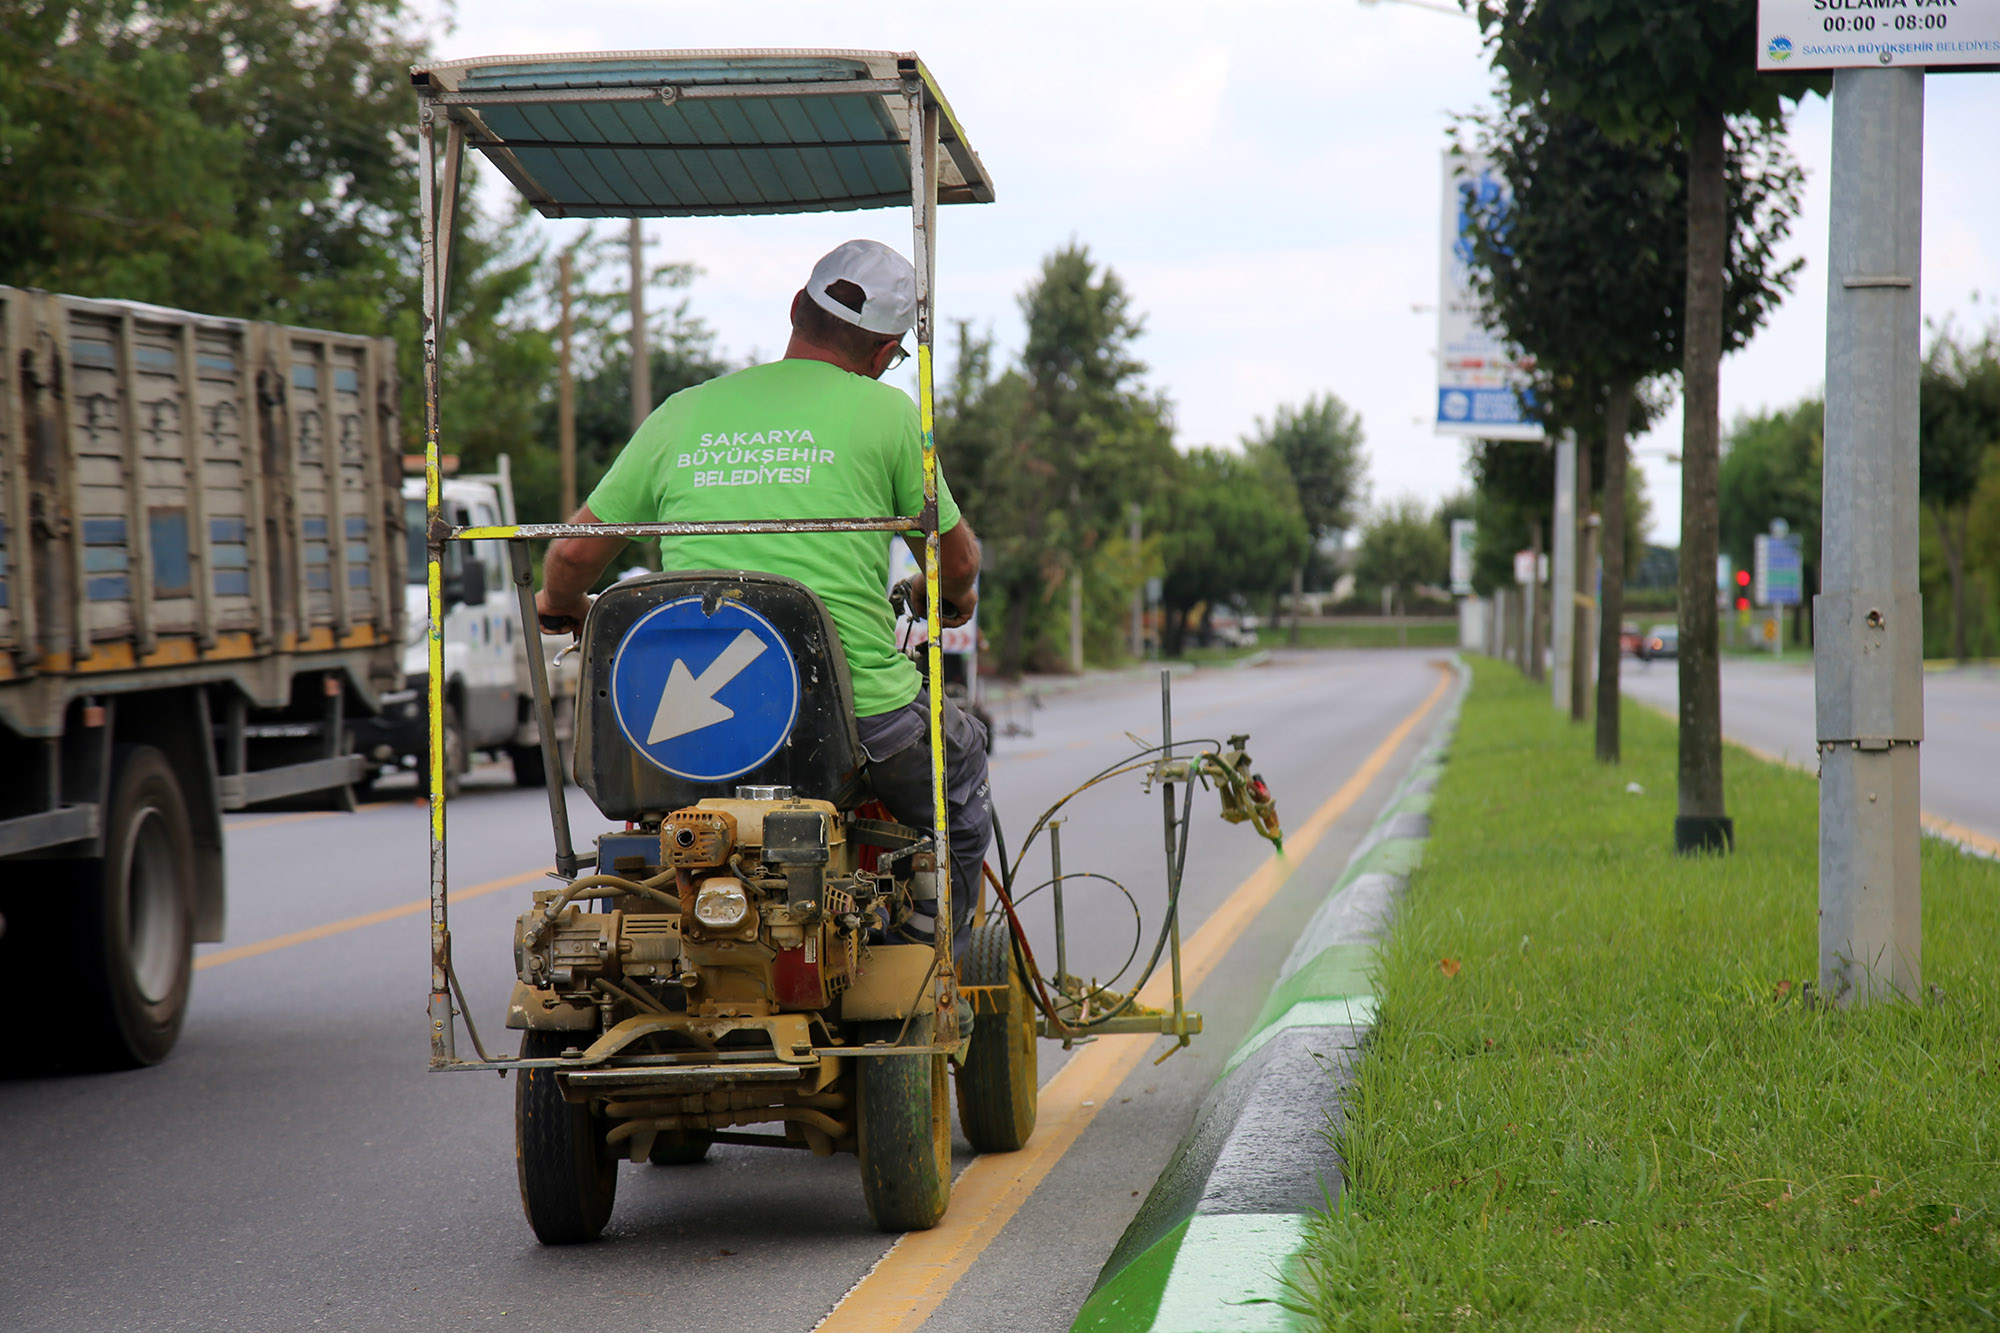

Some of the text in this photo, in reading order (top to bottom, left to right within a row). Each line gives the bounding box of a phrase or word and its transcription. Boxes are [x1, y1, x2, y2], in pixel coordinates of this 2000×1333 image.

[1813, 0, 1907, 10] SULAMA
[1823, 16, 1876, 32] 00:00
[1894, 13, 1947, 31] 08:00
[1802, 44, 1855, 56] SAKARYA
[1857, 41, 1934, 55] BÜYÜKŞEHİR
[700, 429, 815, 447] SAKARYA
[677, 446, 835, 468] BÜYÜKŞEHİR
[693, 465, 811, 488] BELEDİYESİ
